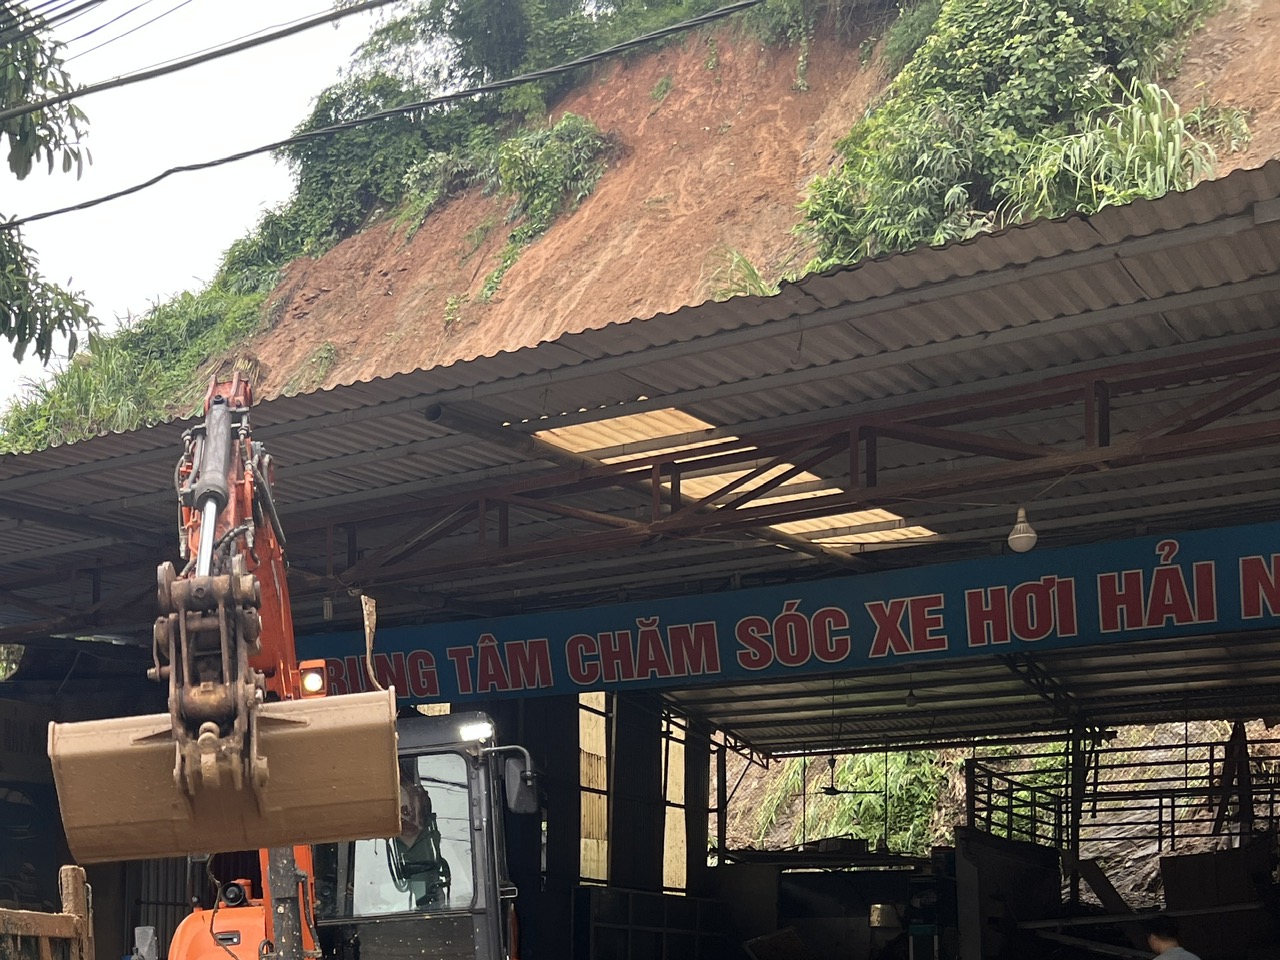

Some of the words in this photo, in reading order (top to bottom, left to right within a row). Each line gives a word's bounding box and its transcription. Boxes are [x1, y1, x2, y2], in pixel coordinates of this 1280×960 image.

[325, 649, 440, 699] RUNG
[446, 632, 554, 695] TÂM
[565, 615, 721, 685] CHĂM
[735, 598, 852, 671] SÓC
[864, 593, 949, 659] XE
[964, 574, 1079, 648] HƠI
[1096, 538, 1218, 634] HẢI
